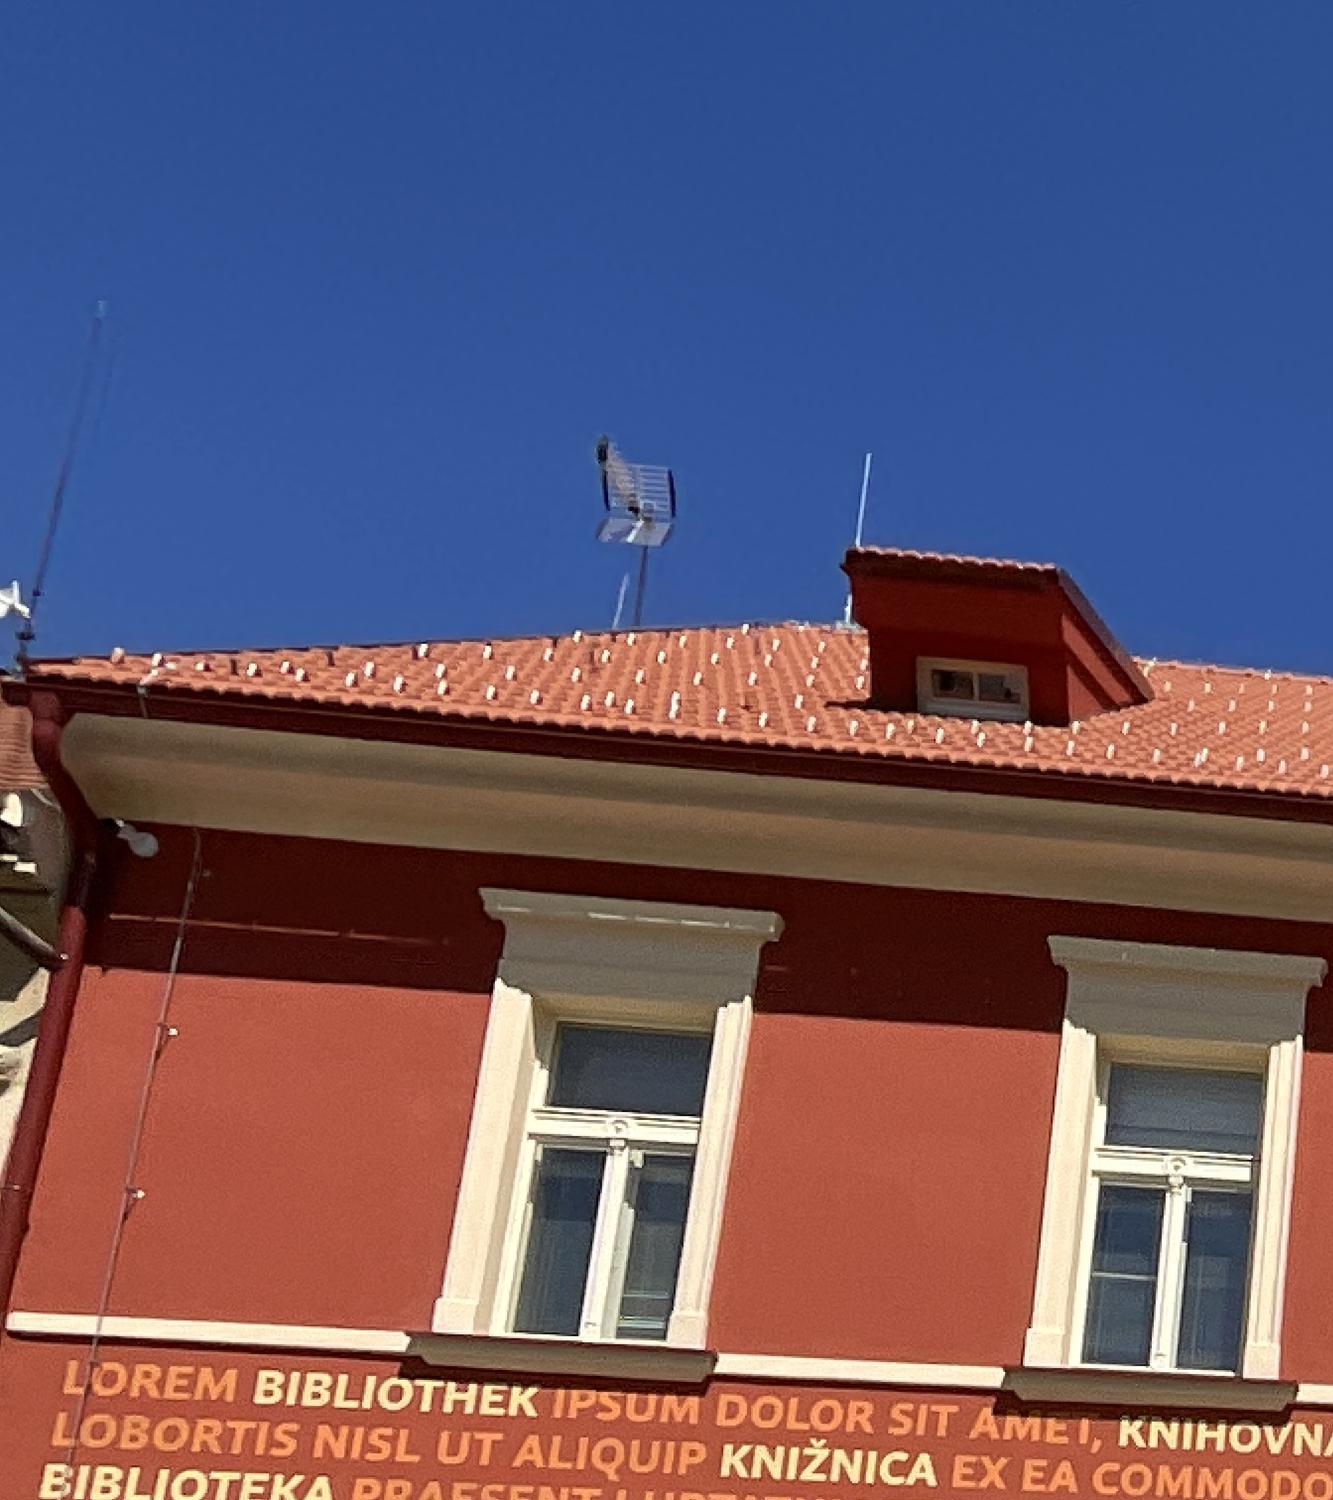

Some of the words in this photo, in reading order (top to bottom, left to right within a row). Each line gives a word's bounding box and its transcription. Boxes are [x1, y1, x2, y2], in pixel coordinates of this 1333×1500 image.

[62, 1359, 238, 1404] LOREM
[253, 1367, 539, 1419] BIBLIOTHEK
[552, 1388, 699, 1425] IPSUM
[716, 1393, 874, 1434] DOLOR
[888, 1402, 959, 1438] SIT
[50, 1412, 298, 1459] LOBORTIS
[313, 1424, 420, 1465] NISL
[436, 1428, 504, 1467] UT
[512, 1434, 707, 1481] ALIQUIP
[720, 1439, 937, 1487] KNIŽNICA
[952, 1455, 1012, 1490] EX
[1022, 1458, 1079, 1494] EA
